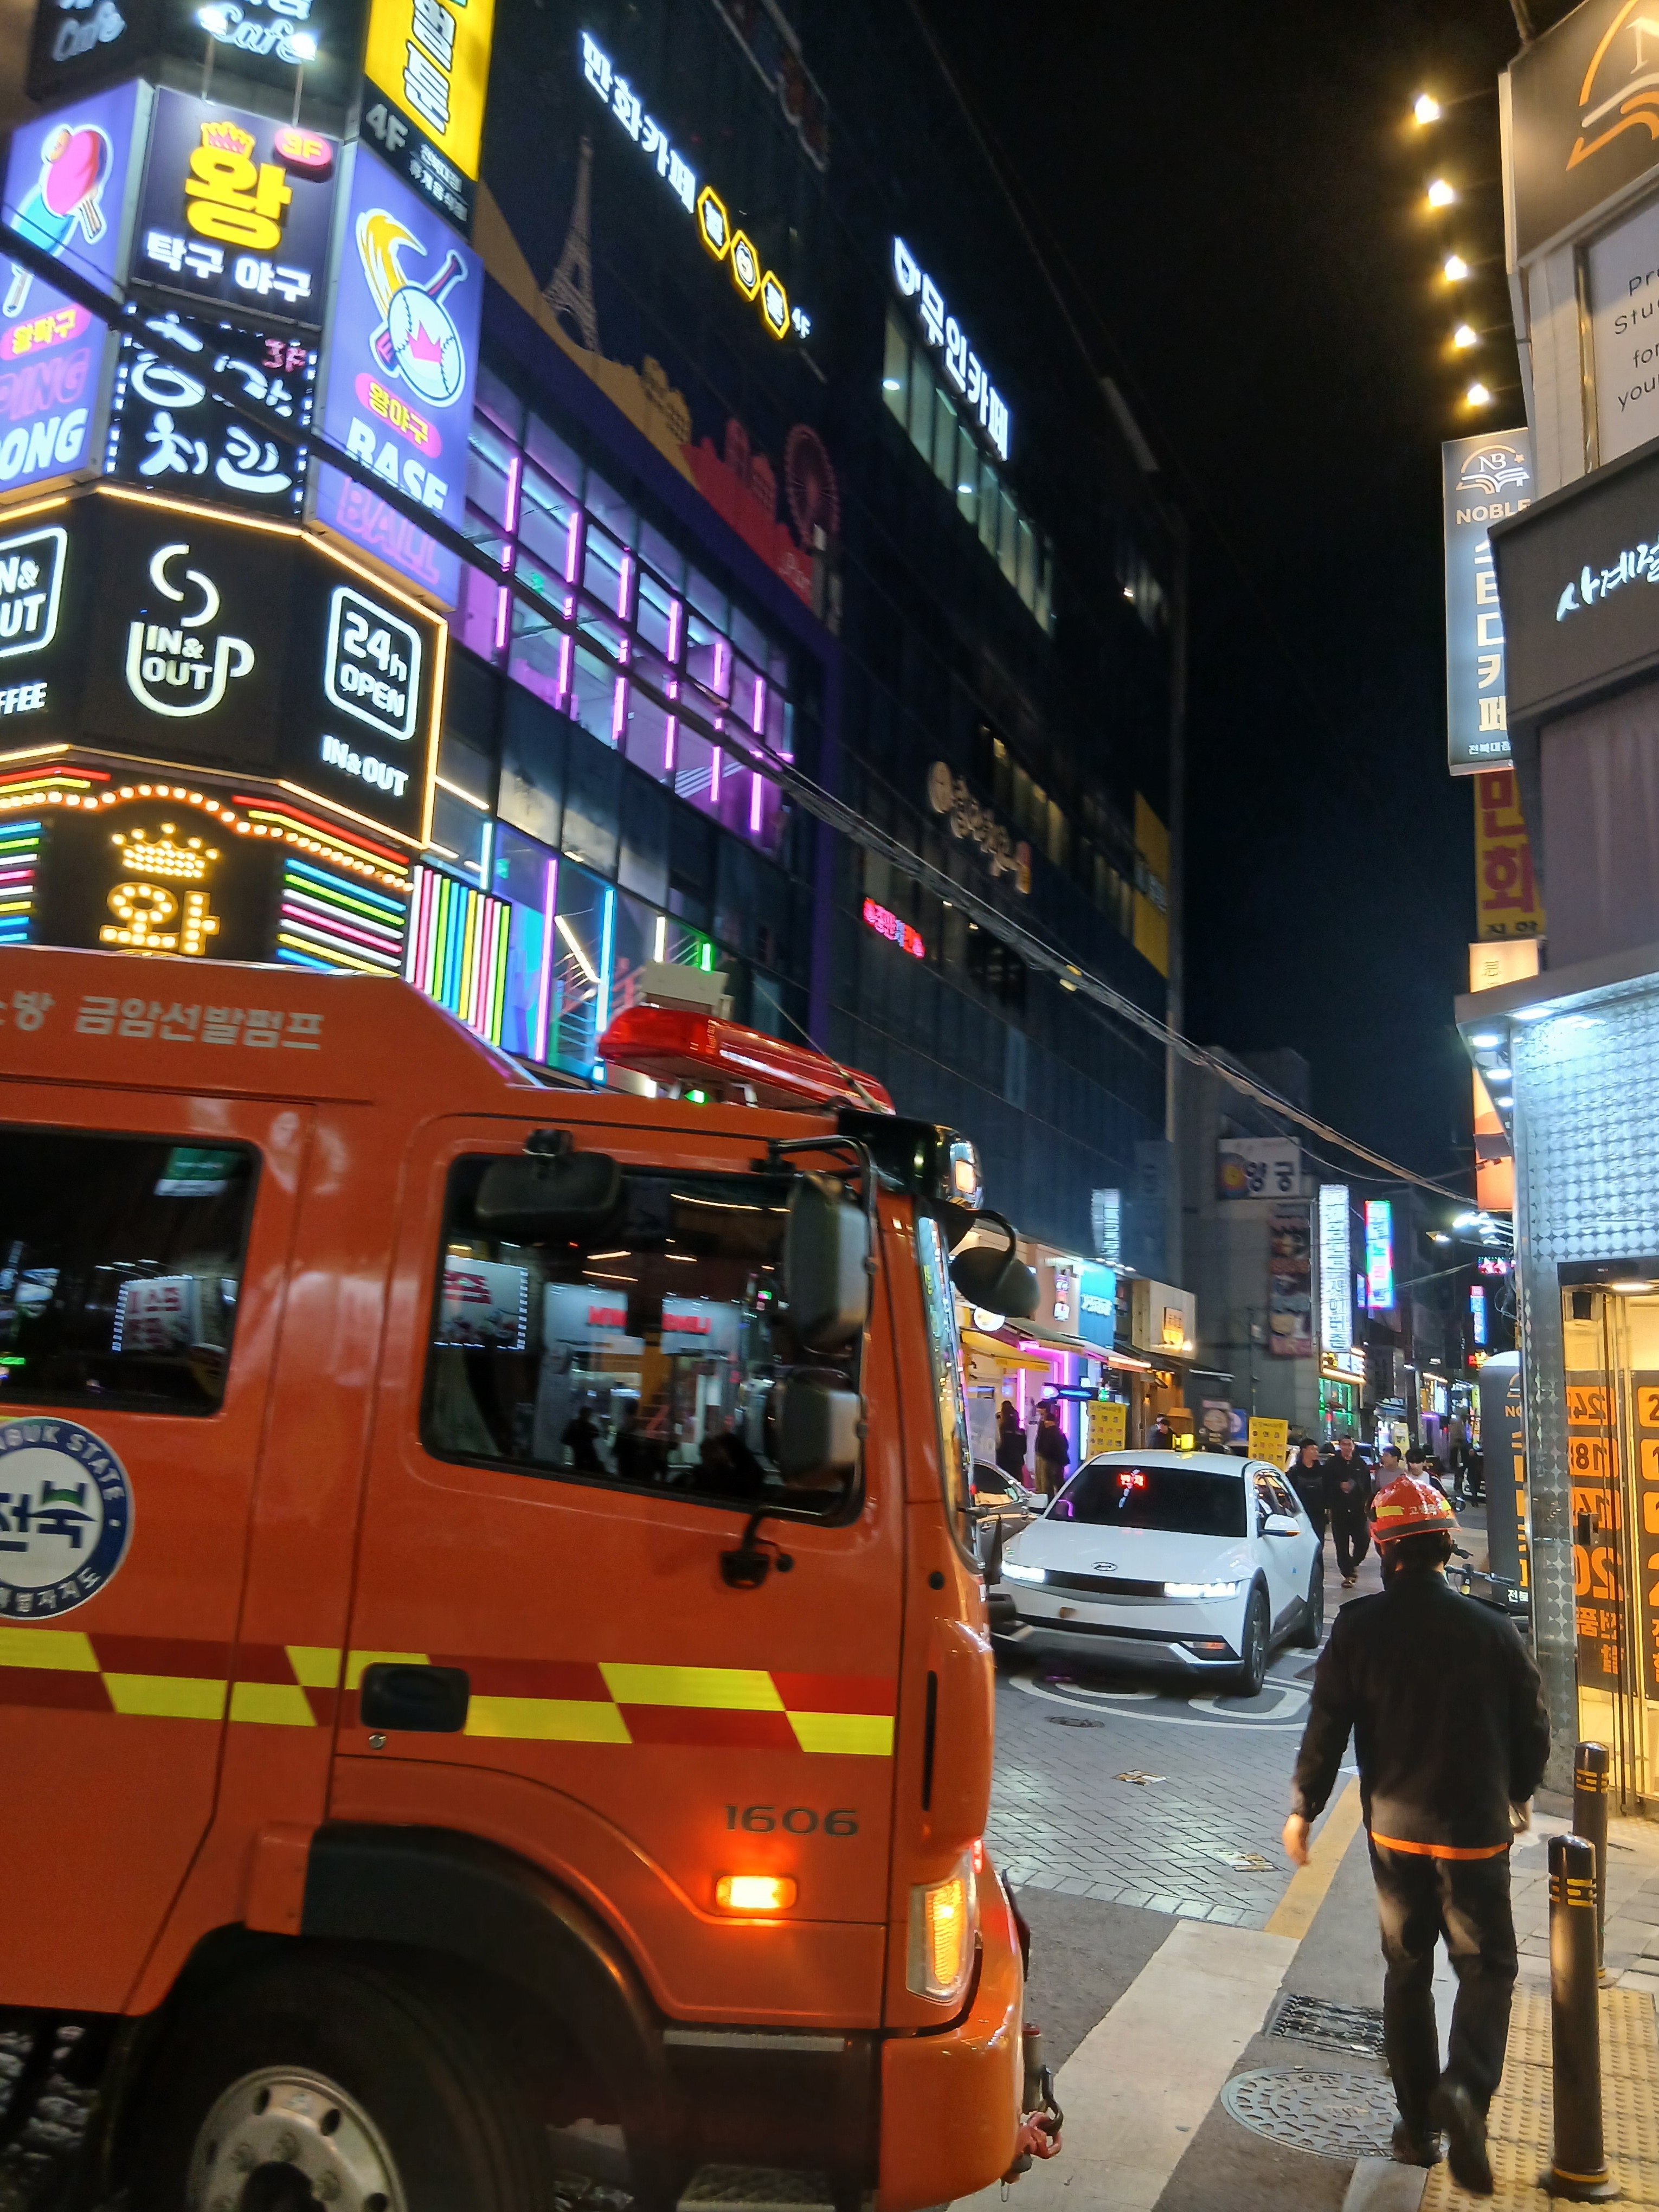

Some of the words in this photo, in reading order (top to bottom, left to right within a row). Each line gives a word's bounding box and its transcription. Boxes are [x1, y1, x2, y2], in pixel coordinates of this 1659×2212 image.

[284, 134, 324, 160] 3F
[365, 103, 408, 152] 4F
[580, 31, 697, 214] 만화카페
[185, 145, 293, 250] 왕
[146, 232, 225, 279] 탁구
[234, 256, 313, 303] 야구
[1629, 268, 1659, 297] pr
[1614, 297, 1659, 335] Stu
[262, 338, 307, 374] 3F
[919, 273, 1009, 462] 무인카페
[368, 381, 429, 446] 왕야구
[1617, 374, 1659, 413] you
[0, 407, 89, 481] ONG
[139, 410, 293, 494] 치킨
[1478, 452, 1507, 472] NB
[337, 477, 440, 585] BALL
[145, 625, 204, 659] IN&
[343, 610, 408, 682] 24h
[142, 656, 213, 690] OUT
[340, 662, 406, 718] OPEN
[322, 734, 409, 797] IN&OUT
[1468, 741, 1511, 756] 전북대점
[75, 995, 324, 1051] 금암선발펌프
[0, 1424, 61, 1451] BUK
[66, 1433, 125, 1500] STATE
[724, 1804, 859, 1837] 1606
